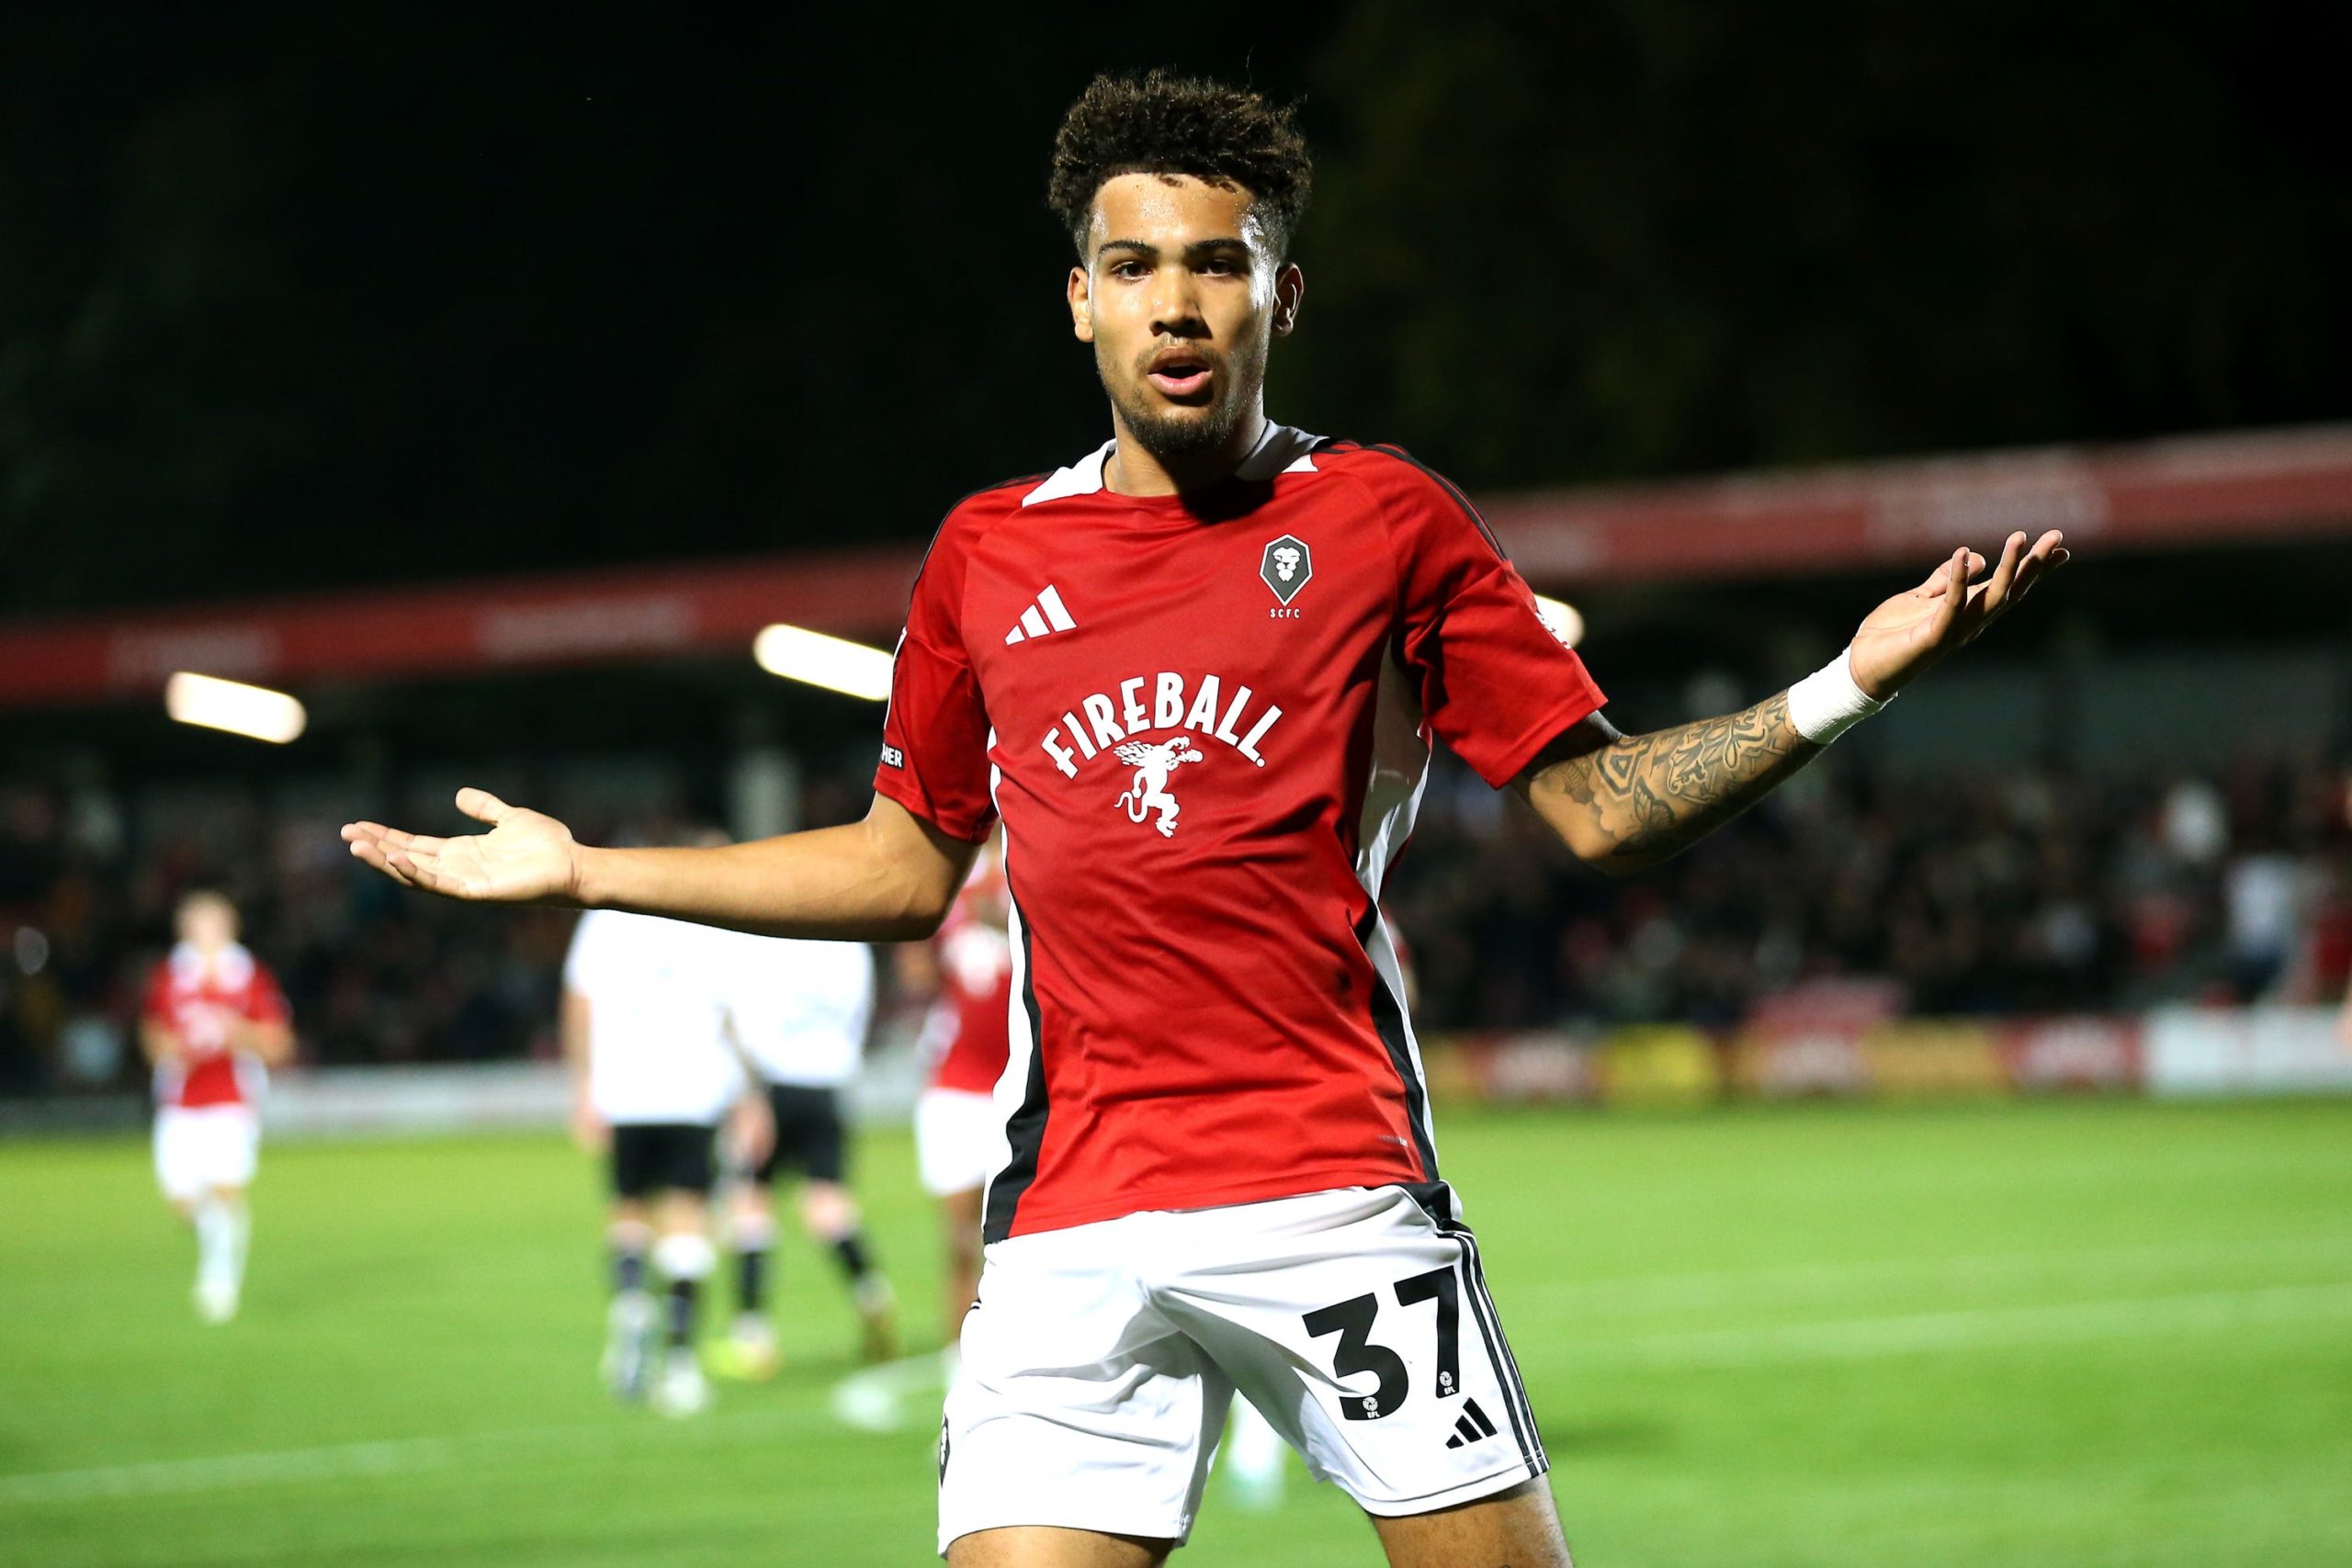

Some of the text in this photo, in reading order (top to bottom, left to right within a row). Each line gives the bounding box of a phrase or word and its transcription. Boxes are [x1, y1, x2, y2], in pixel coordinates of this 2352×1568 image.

[1270, 608, 1300, 618] SCFC
[1302, 1265, 1459, 1420] 37
[1443, 1385, 1456, 1395] EFL
[1366, 1410, 1381, 1418] EFL
